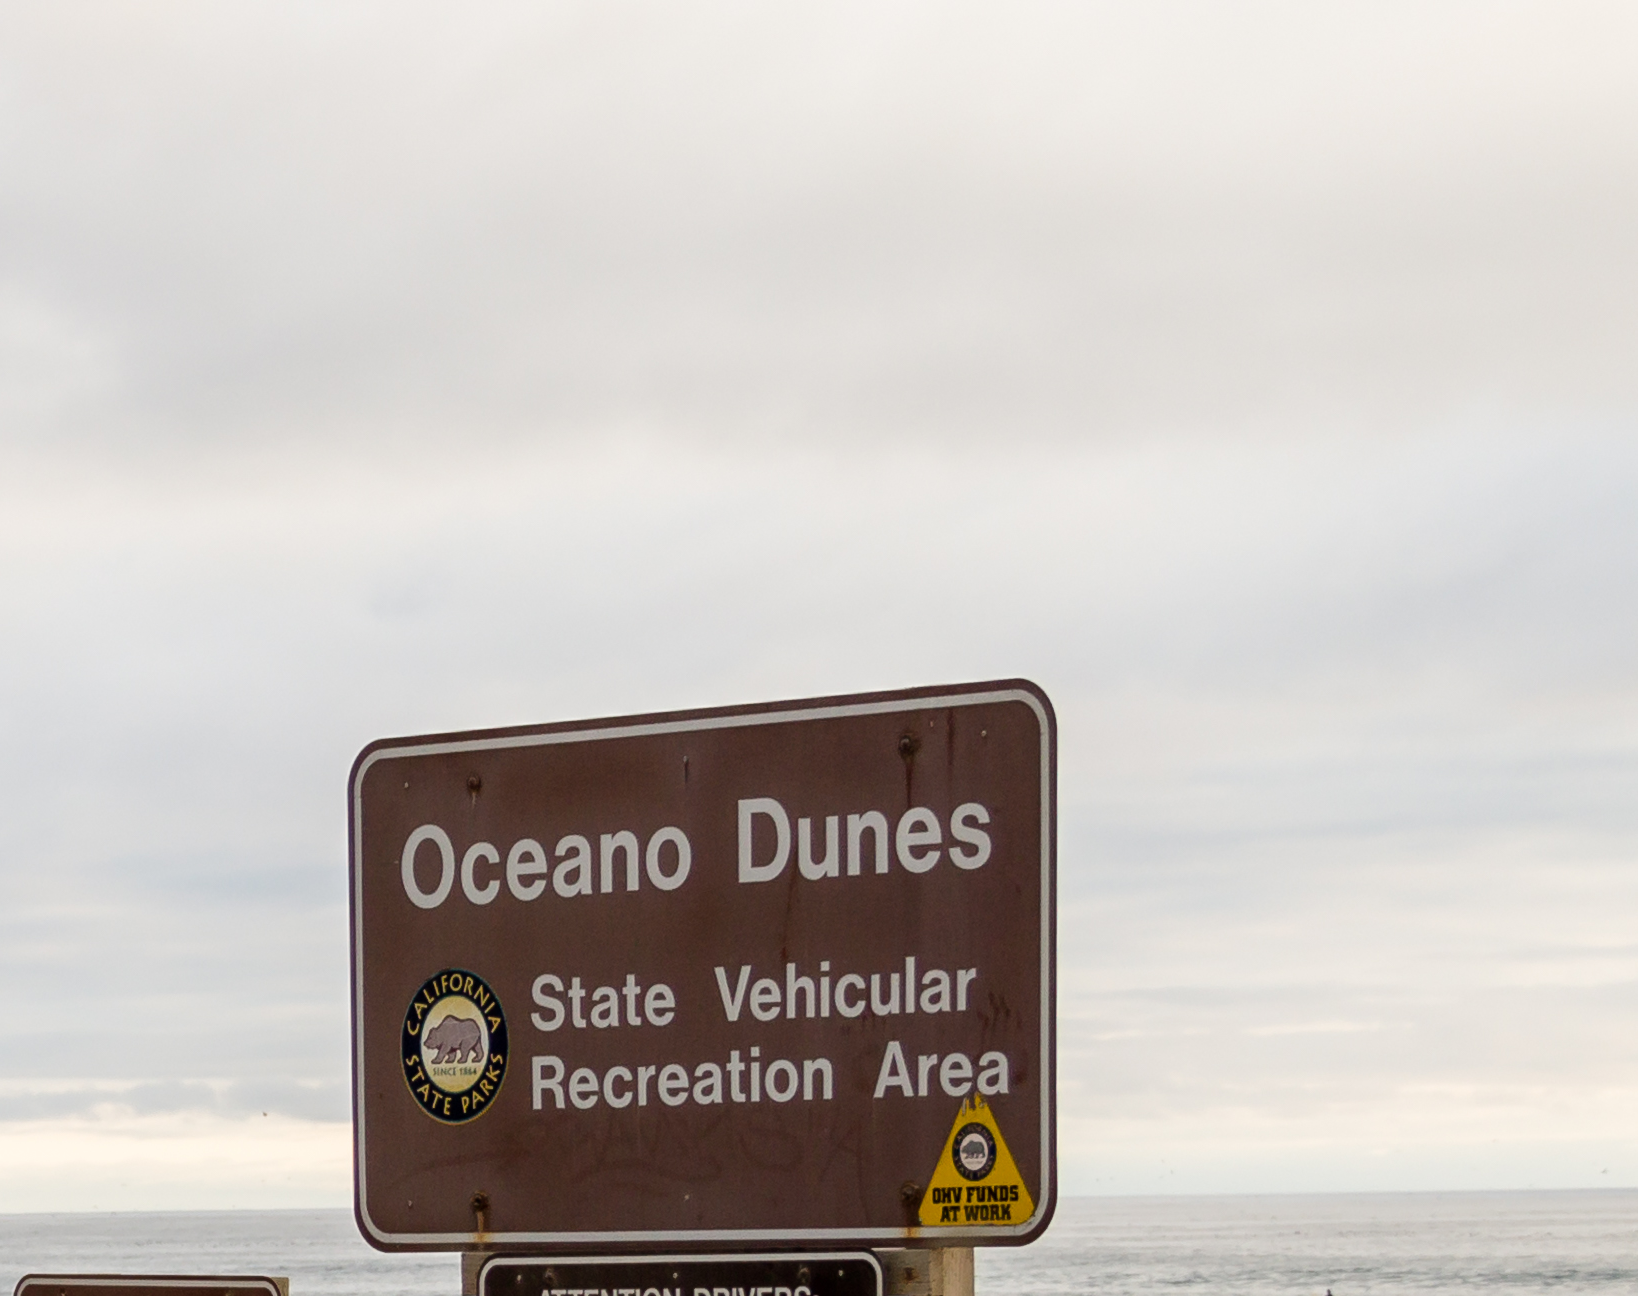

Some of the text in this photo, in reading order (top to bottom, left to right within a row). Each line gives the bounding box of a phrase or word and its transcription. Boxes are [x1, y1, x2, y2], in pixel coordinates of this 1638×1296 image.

[401, 797, 993, 910] Oceano Dunes
[407, 974, 501, 1035] CALIFORNIA
[530, 956, 977, 1032] State Vehicular
[406, 1054, 502, 1115] STATE PARKS
[433, 1067, 456, 1076] SINCE
[531, 1041, 1010, 1110] Recreation Area
[933, 1185, 1018, 1204] OHV FUNDS
[940, 1204, 1011, 1222] AT WORK
